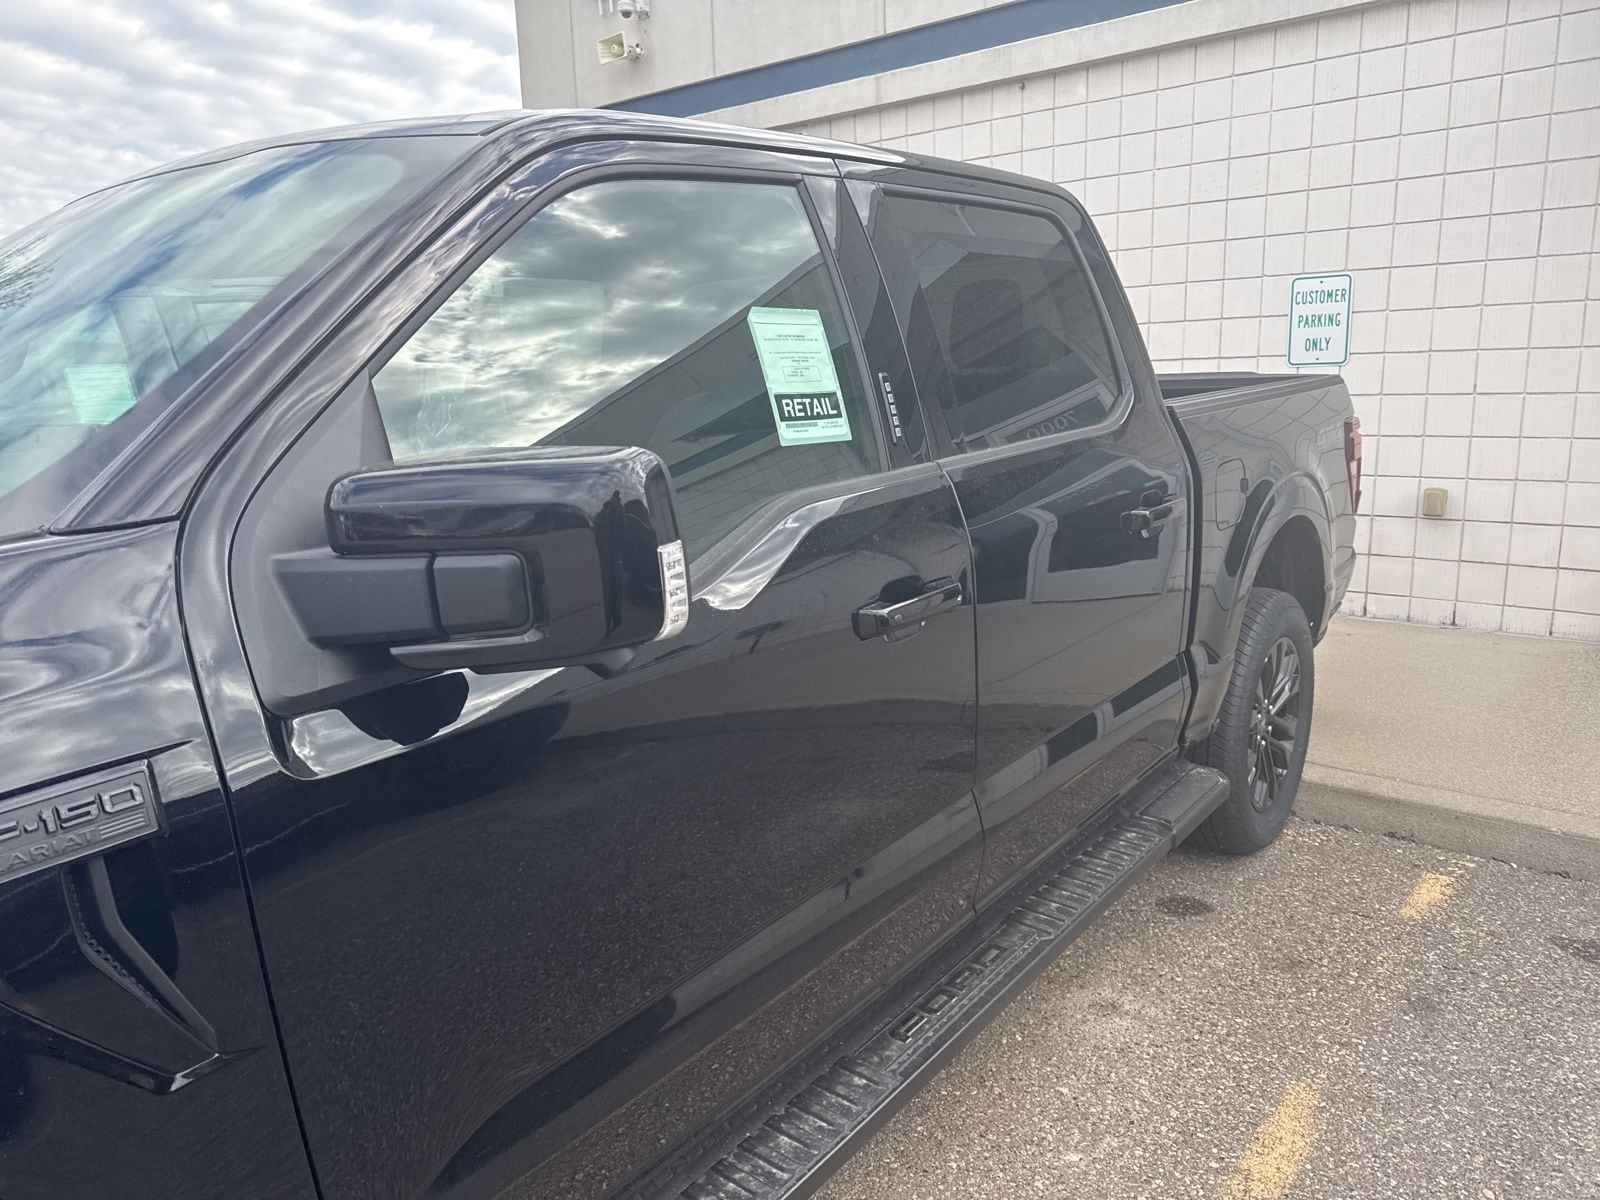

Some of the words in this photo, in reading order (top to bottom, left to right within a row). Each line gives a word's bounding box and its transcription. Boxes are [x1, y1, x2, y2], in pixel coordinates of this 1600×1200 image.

[1295, 288, 1347, 306] CUSTOMER
[1297, 312, 1341, 329] PARKING
[1304, 337, 1331, 352] ONLY
[781, 398, 838, 418] RETAIL
[0, 827, 96, 872] ARIAT
